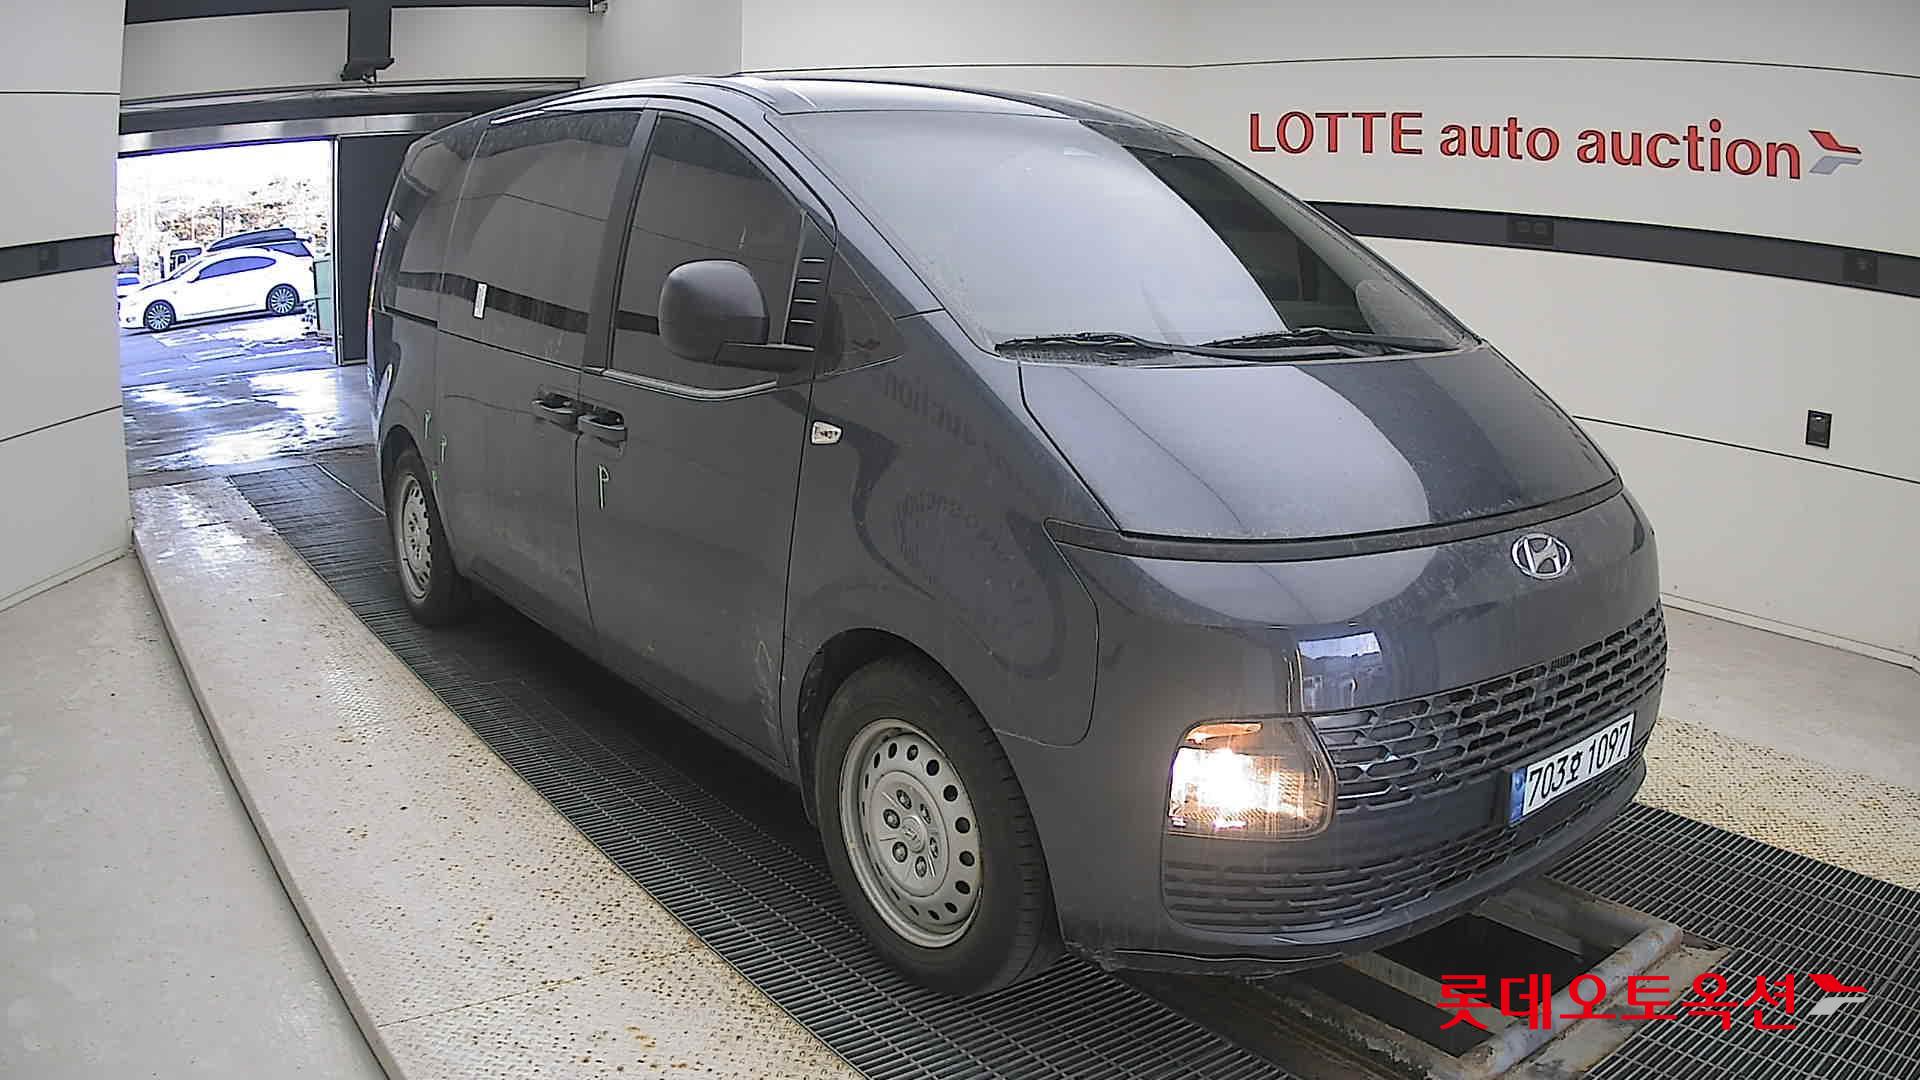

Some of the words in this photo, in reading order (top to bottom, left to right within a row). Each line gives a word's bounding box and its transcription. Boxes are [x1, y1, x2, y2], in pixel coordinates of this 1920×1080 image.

[1249, 111, 1423, 155] LOTTE
[1440, 117, 1560, 161] auto
[1576, 119, 1801, 180] auction
[1528, 751, 1584, 808] 703호
[1588, 721, 1631, 775] 1097
